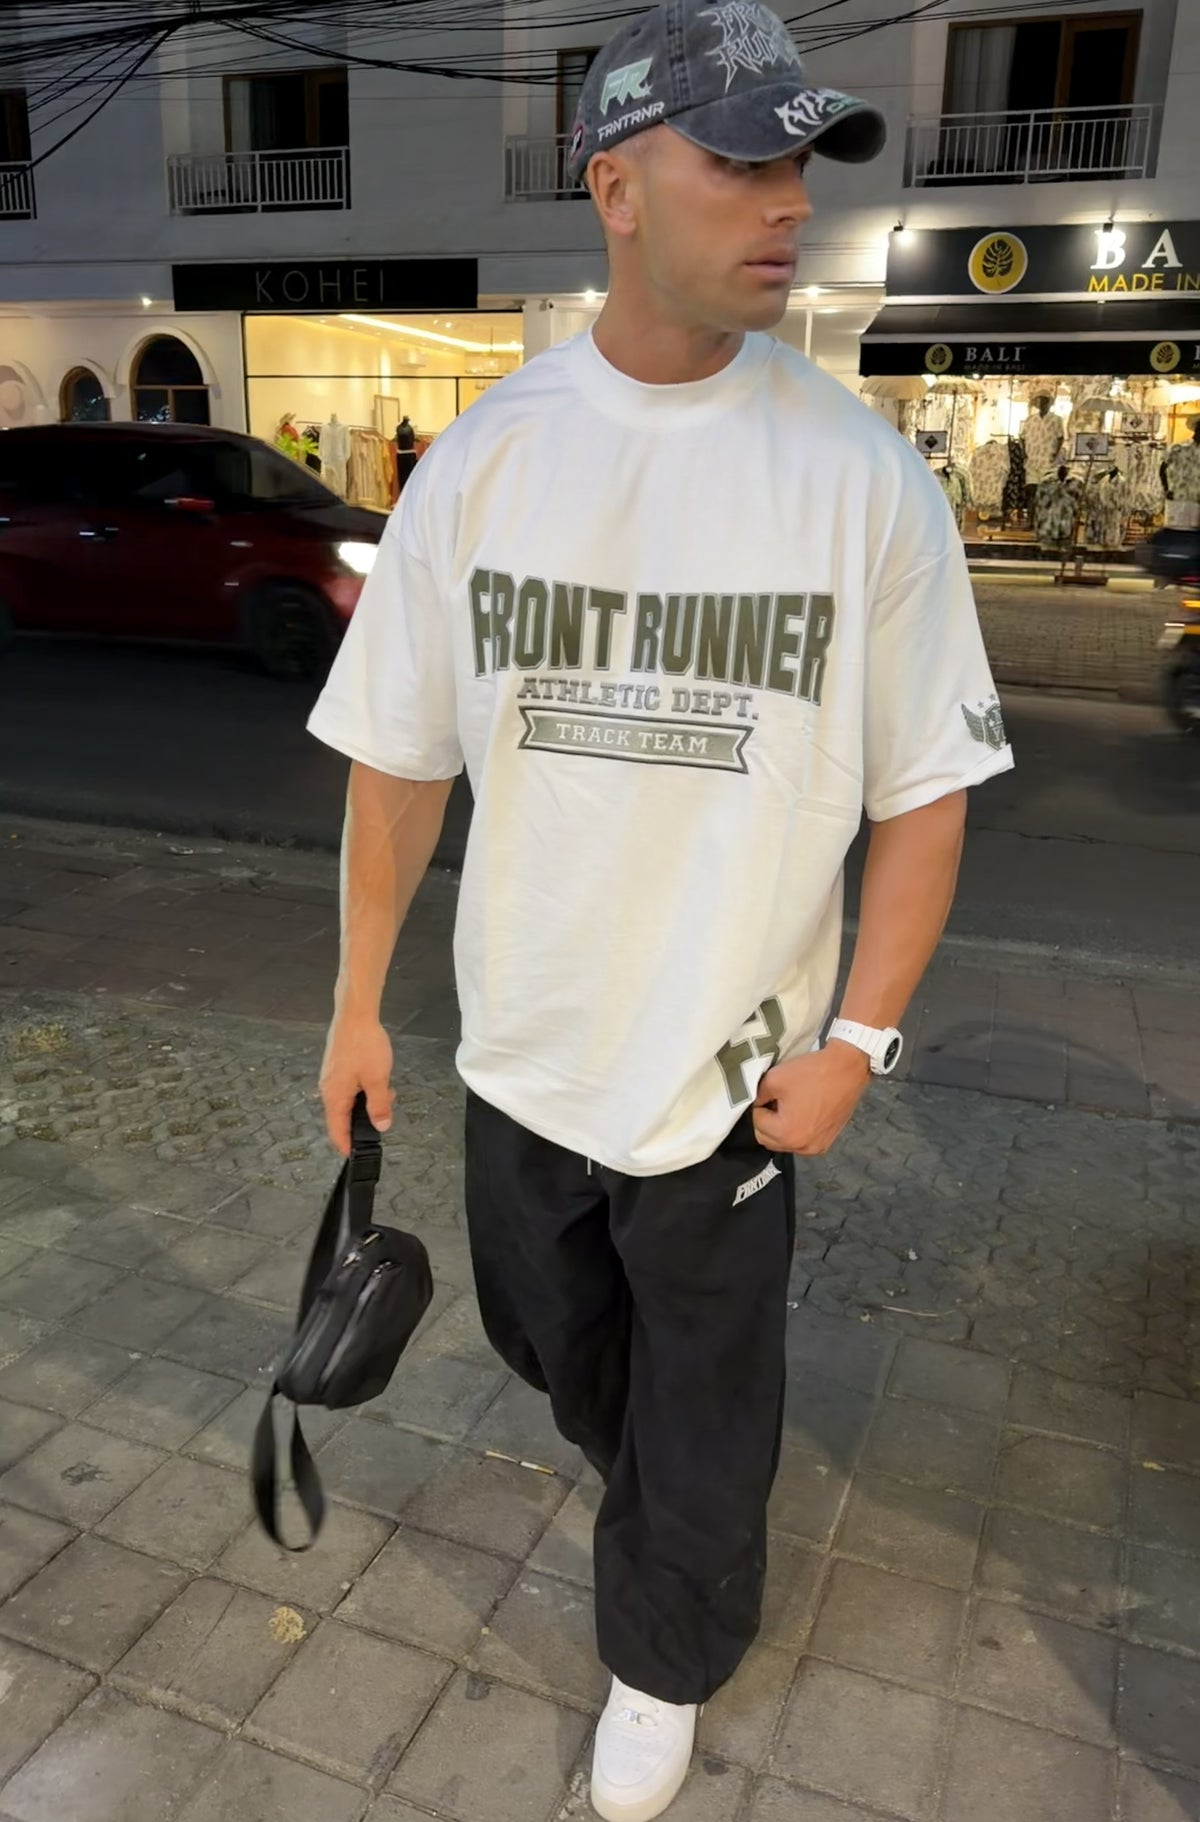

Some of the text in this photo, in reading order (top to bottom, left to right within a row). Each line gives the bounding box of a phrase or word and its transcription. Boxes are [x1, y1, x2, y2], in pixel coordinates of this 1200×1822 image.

[597, 101, 665, 142] FRNTRNR
[255, 268, 384, 303] KOHEI
[1087, 272, 1200, 292] MADE IN
[964, 346, 1021, 362] BALI
[468, 566, 836, 706] FRONT RUNNER
[517, 677, 759, 720] ATHLETIC DEPT.
[556, 723, 708, 753] TRACK TEAM
